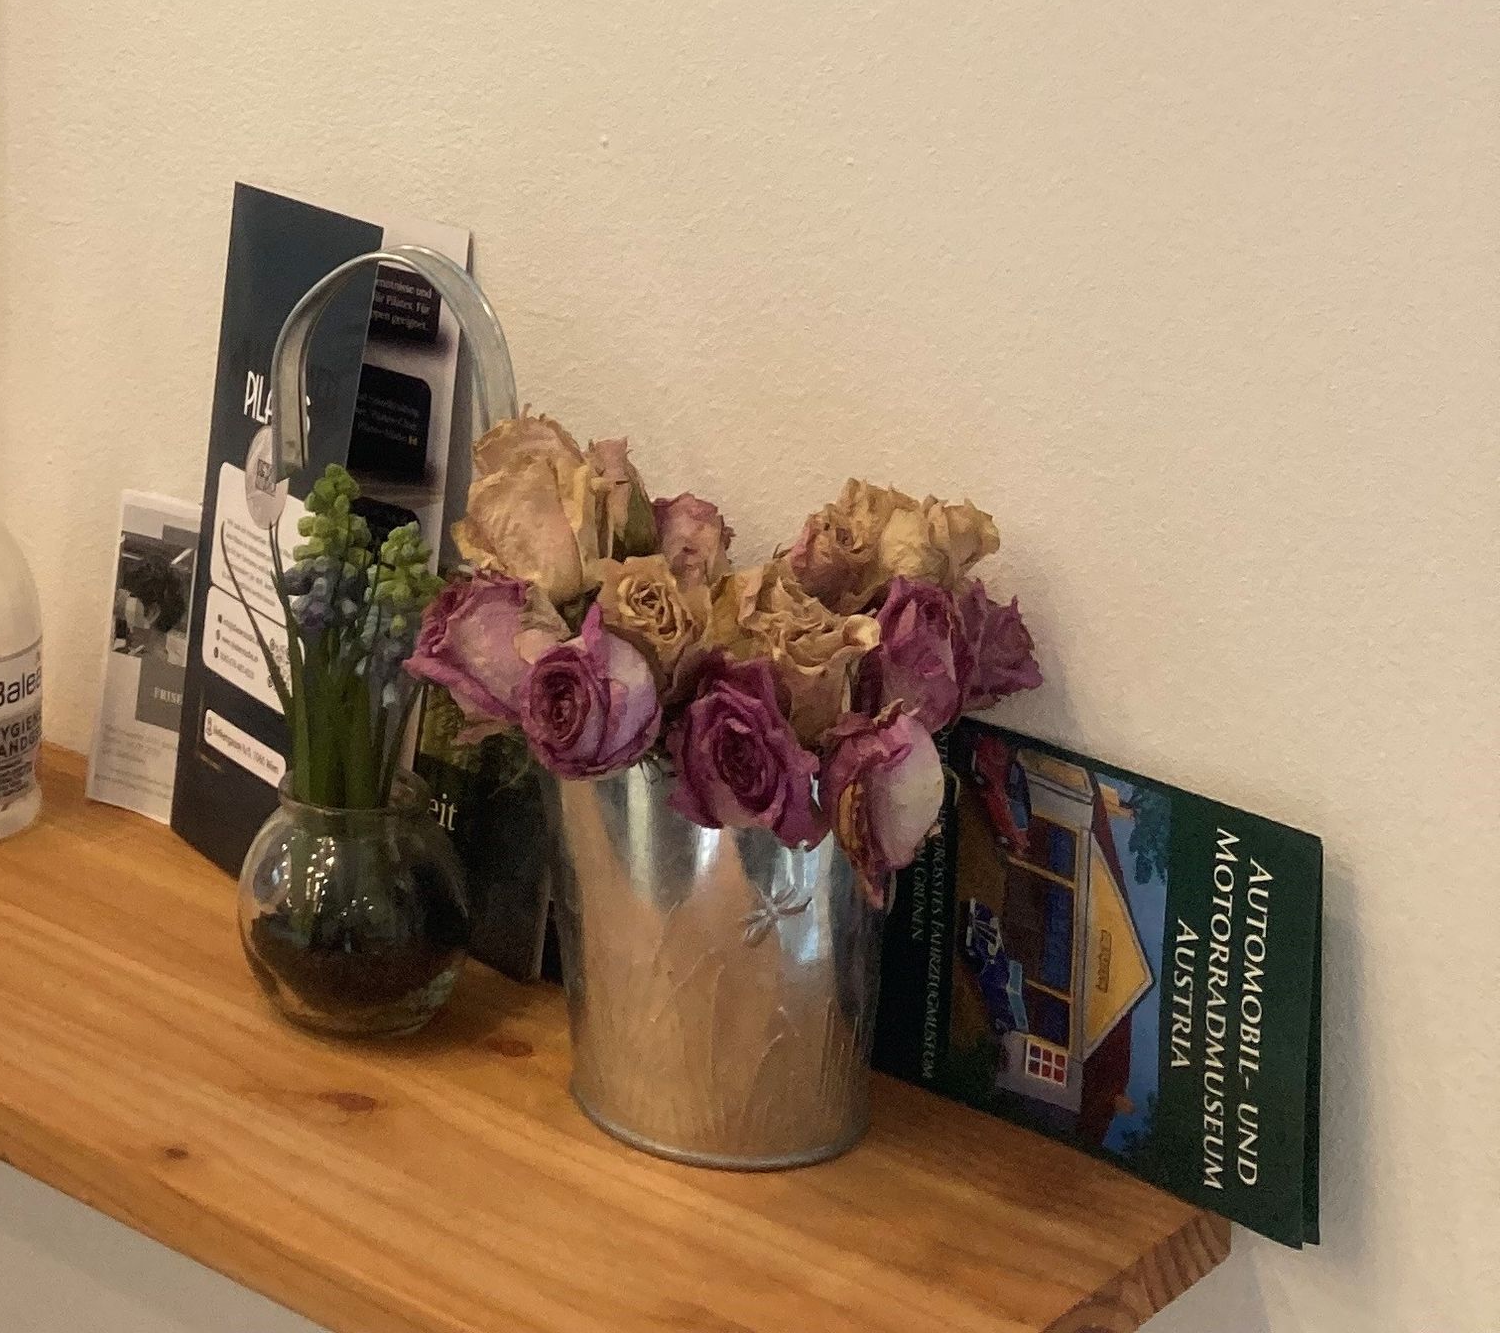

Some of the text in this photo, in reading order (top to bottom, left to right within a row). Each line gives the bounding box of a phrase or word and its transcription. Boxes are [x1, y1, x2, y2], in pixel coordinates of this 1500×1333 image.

[1170, 917, 1201, 1070] AUSTRIA
[1203, 827, 1241, 1191] MOTORRADMUSEUM
[1237, 857, 1275, 1187] AUTOMOBIL- UND
